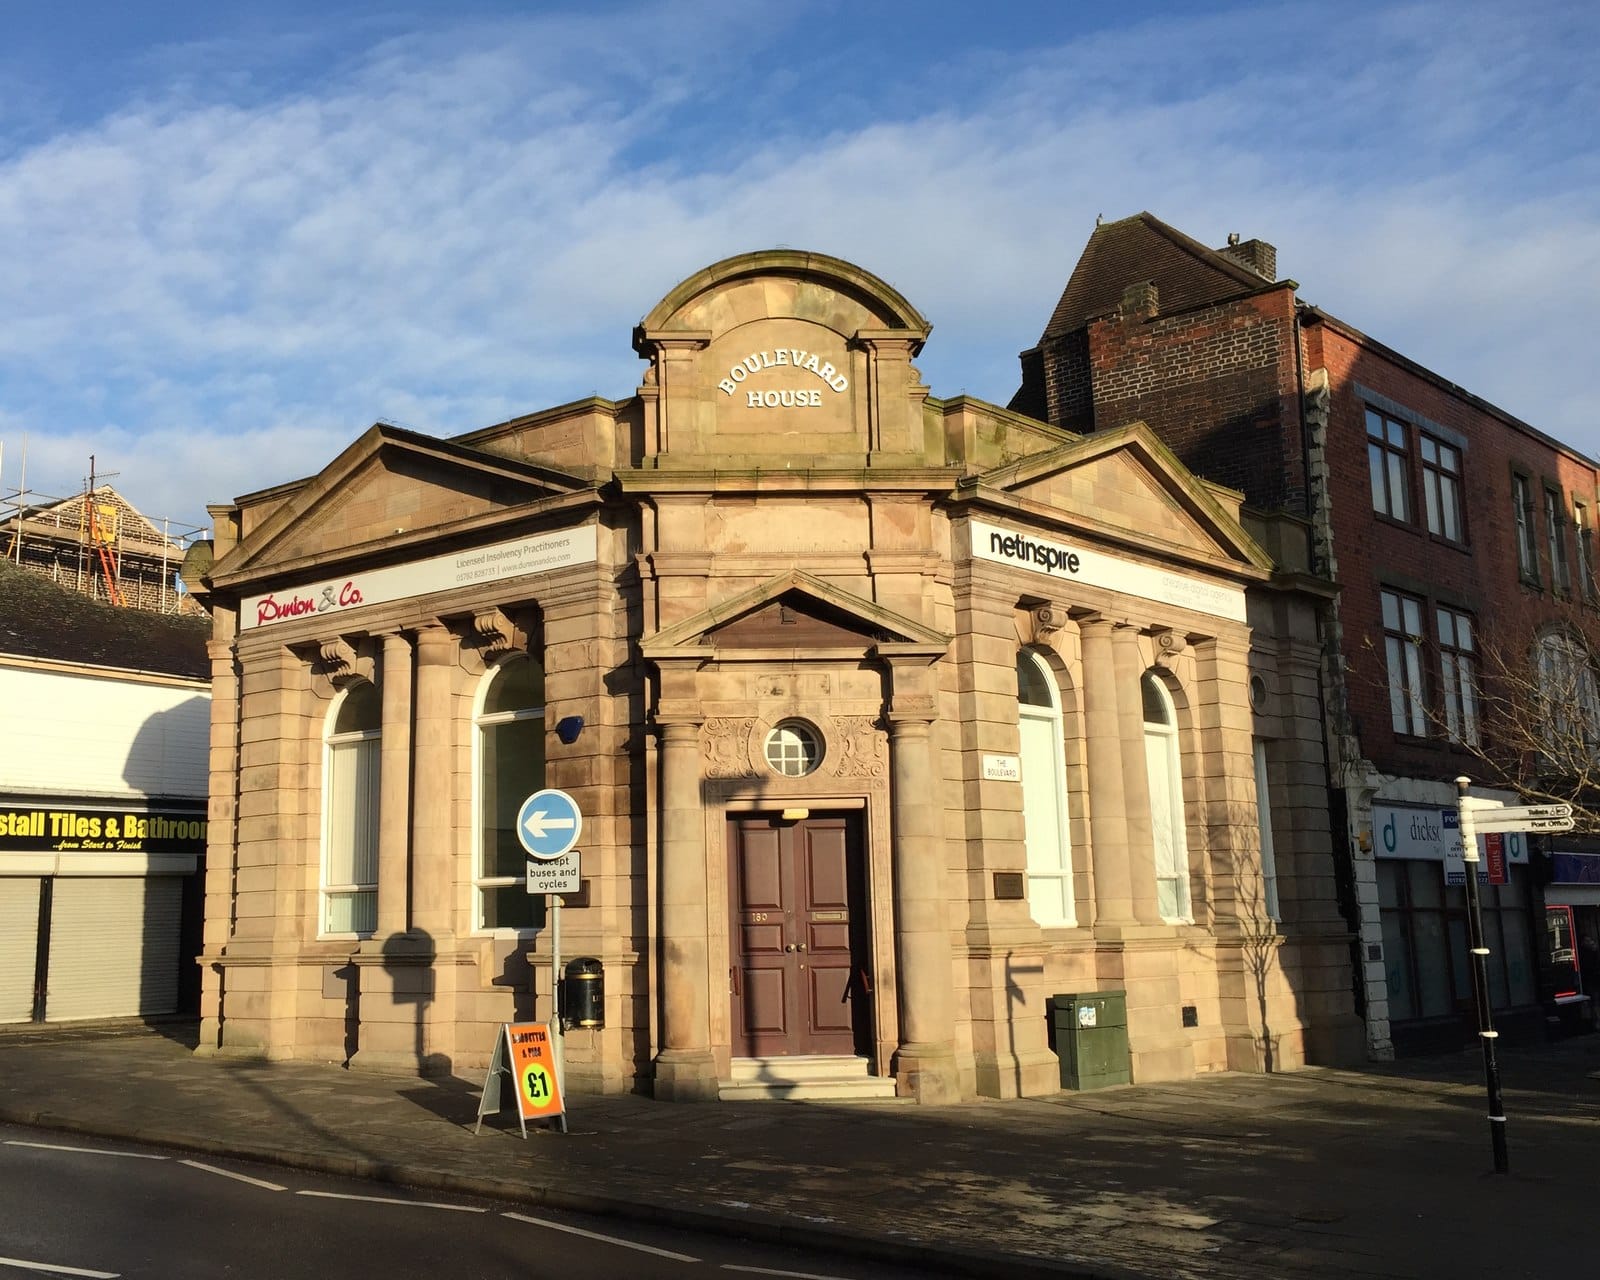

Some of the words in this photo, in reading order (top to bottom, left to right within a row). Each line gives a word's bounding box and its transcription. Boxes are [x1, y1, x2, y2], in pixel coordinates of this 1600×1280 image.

[718, 349, 849, 396] BOULEVARD
[747, 390, 822, 408] HOUSE
[456, 554, 485, 568] Licensed
[486, 548, 522, 563] Insolvency
[523, 538, 570, 554] Practitioners
[990, 532, 1080, 573] netinspire
[257, 595, 316, 626] Dunion
[318, 586, 337, 612] &
[339, 581, 363, 607] Co.
[988, 768, 1016, 777] BOULEVARD
[0, 811, 45, 837] stall
[50, 812, 101, 837] Tiles
[105, 817, 120, 838] &
[81, 839, 105, 849] Start
[105, 840, 114, 849] to
[116, 840, 142, 850] Finish
[530, 868, 557, 877] buses
[559, 867, 577, 877] and
[539, 879, 568, 890] cycles
[527, 1071, 548, 1098] £1
